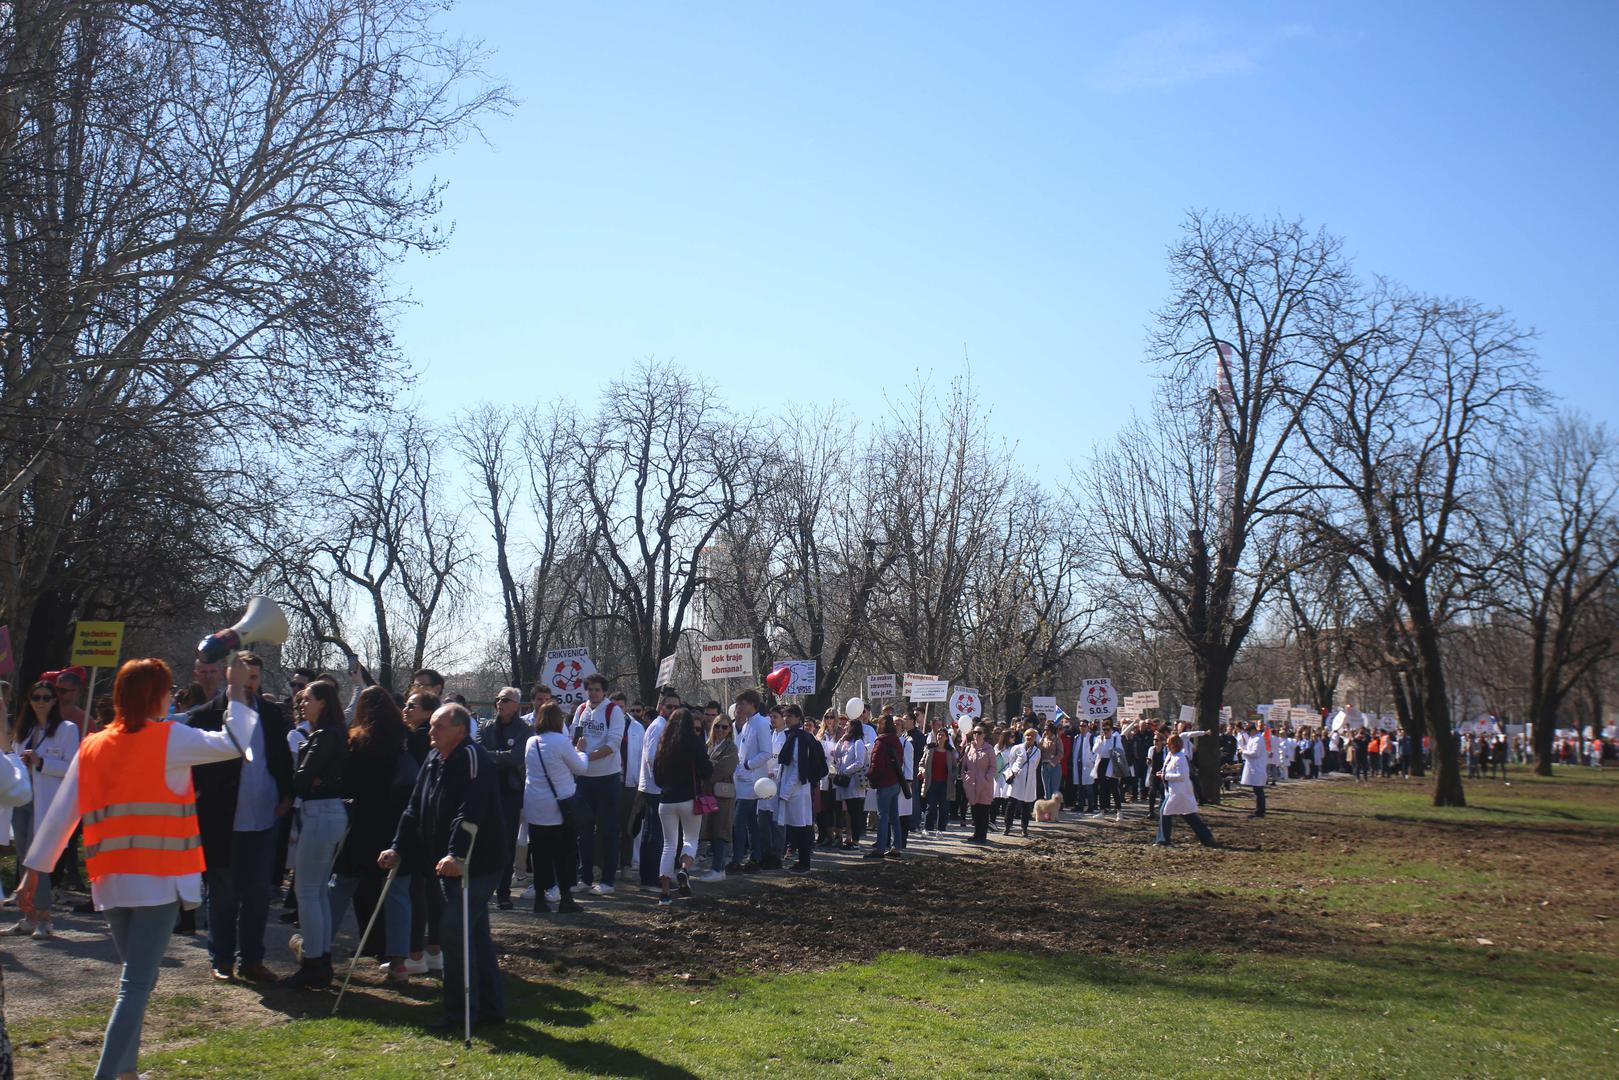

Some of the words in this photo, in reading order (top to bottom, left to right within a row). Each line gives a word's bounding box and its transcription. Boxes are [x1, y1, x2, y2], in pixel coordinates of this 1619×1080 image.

[703, 644, 722, 652] Nema
[724, 642, 751, 650] odmora
[548, 648, 588, 659] CRIKVENICA
[711, 655, 725, 663] dok
[726, 653, 743, 662] traje
[711, 664, 742, 674] obmana!
[1089, 706, 1111, 715] S.O.S.
